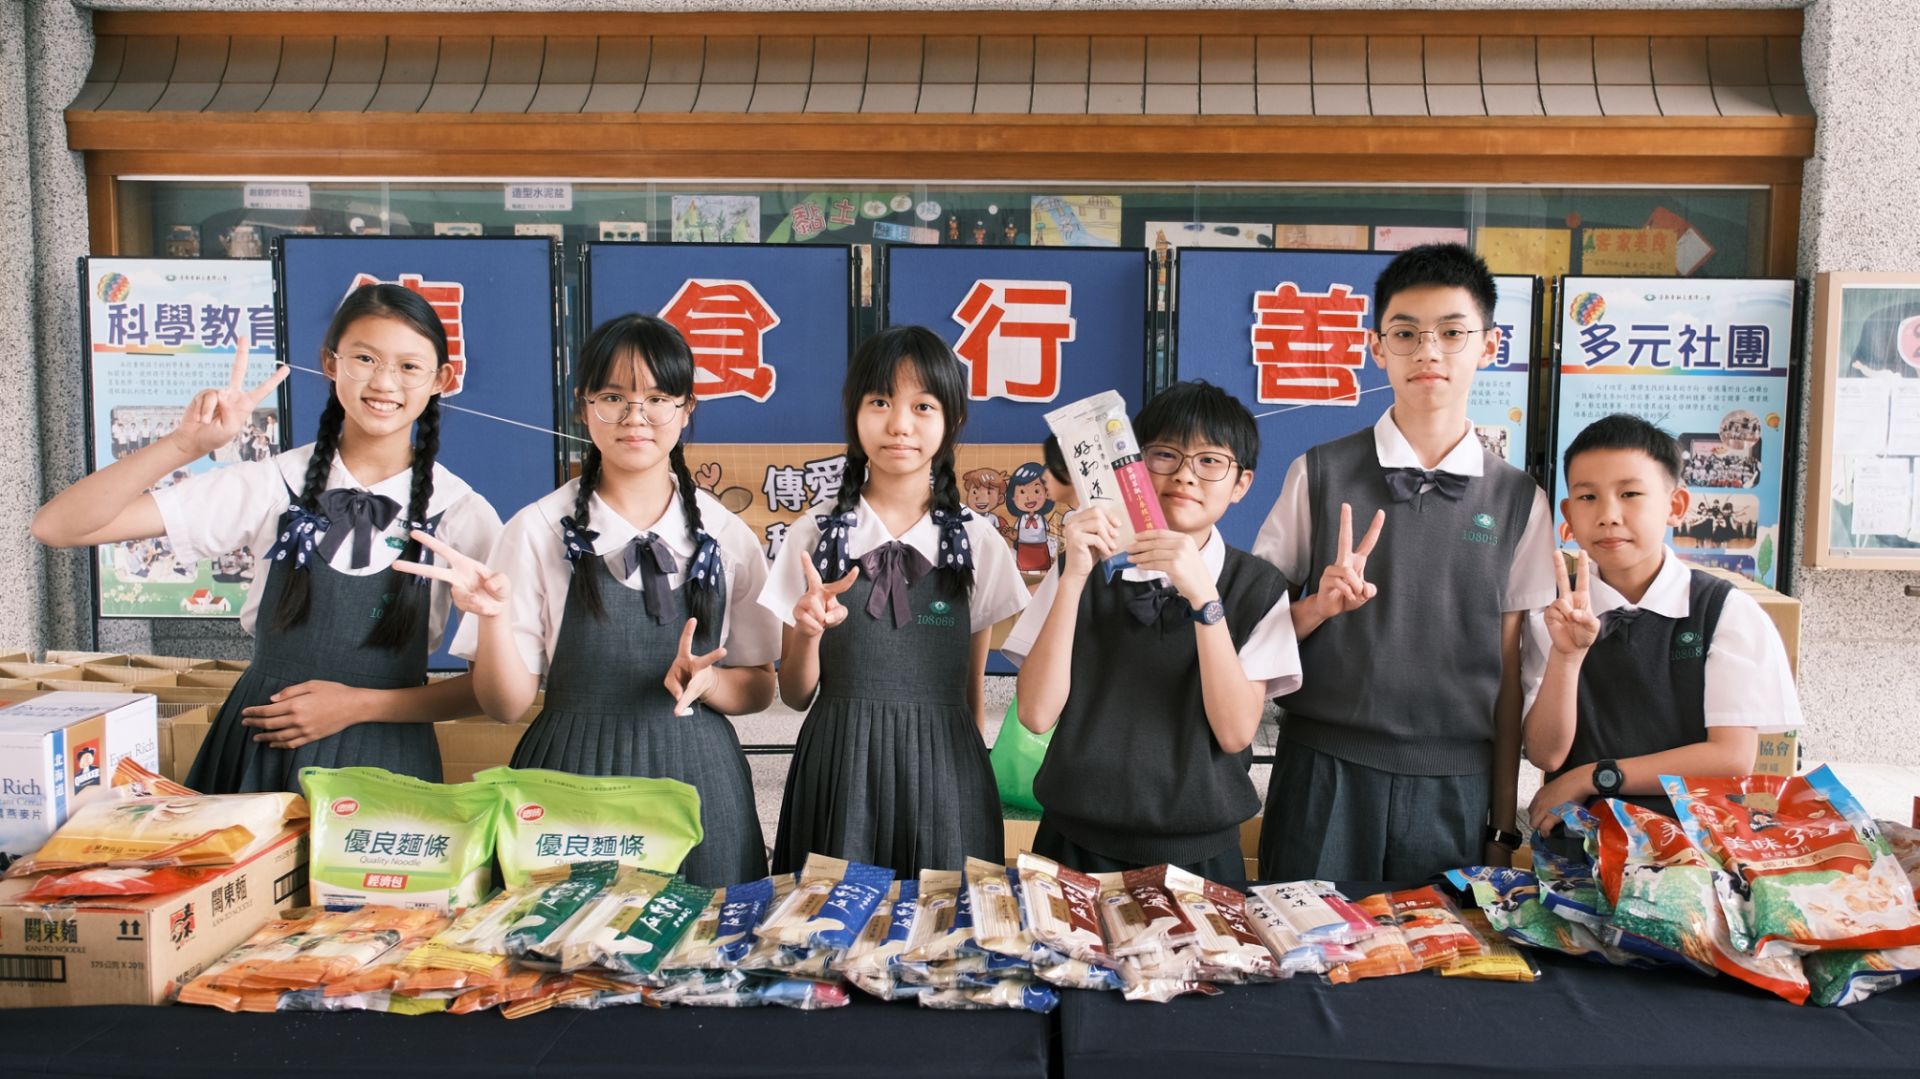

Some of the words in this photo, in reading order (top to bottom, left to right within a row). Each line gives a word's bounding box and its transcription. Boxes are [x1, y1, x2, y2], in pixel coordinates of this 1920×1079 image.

[953, 282, 1072, 398] 行
[1256, 285, 1364, 402] 善
[1579, 323, 1770, 368] 多元社團
[3, 778, 41, 795] Rich
[344, 828, 450, 858] 優良麵條
[536, 832, 645, 857] 優良麵條
[24, 917, 78, 943] 關東麵
